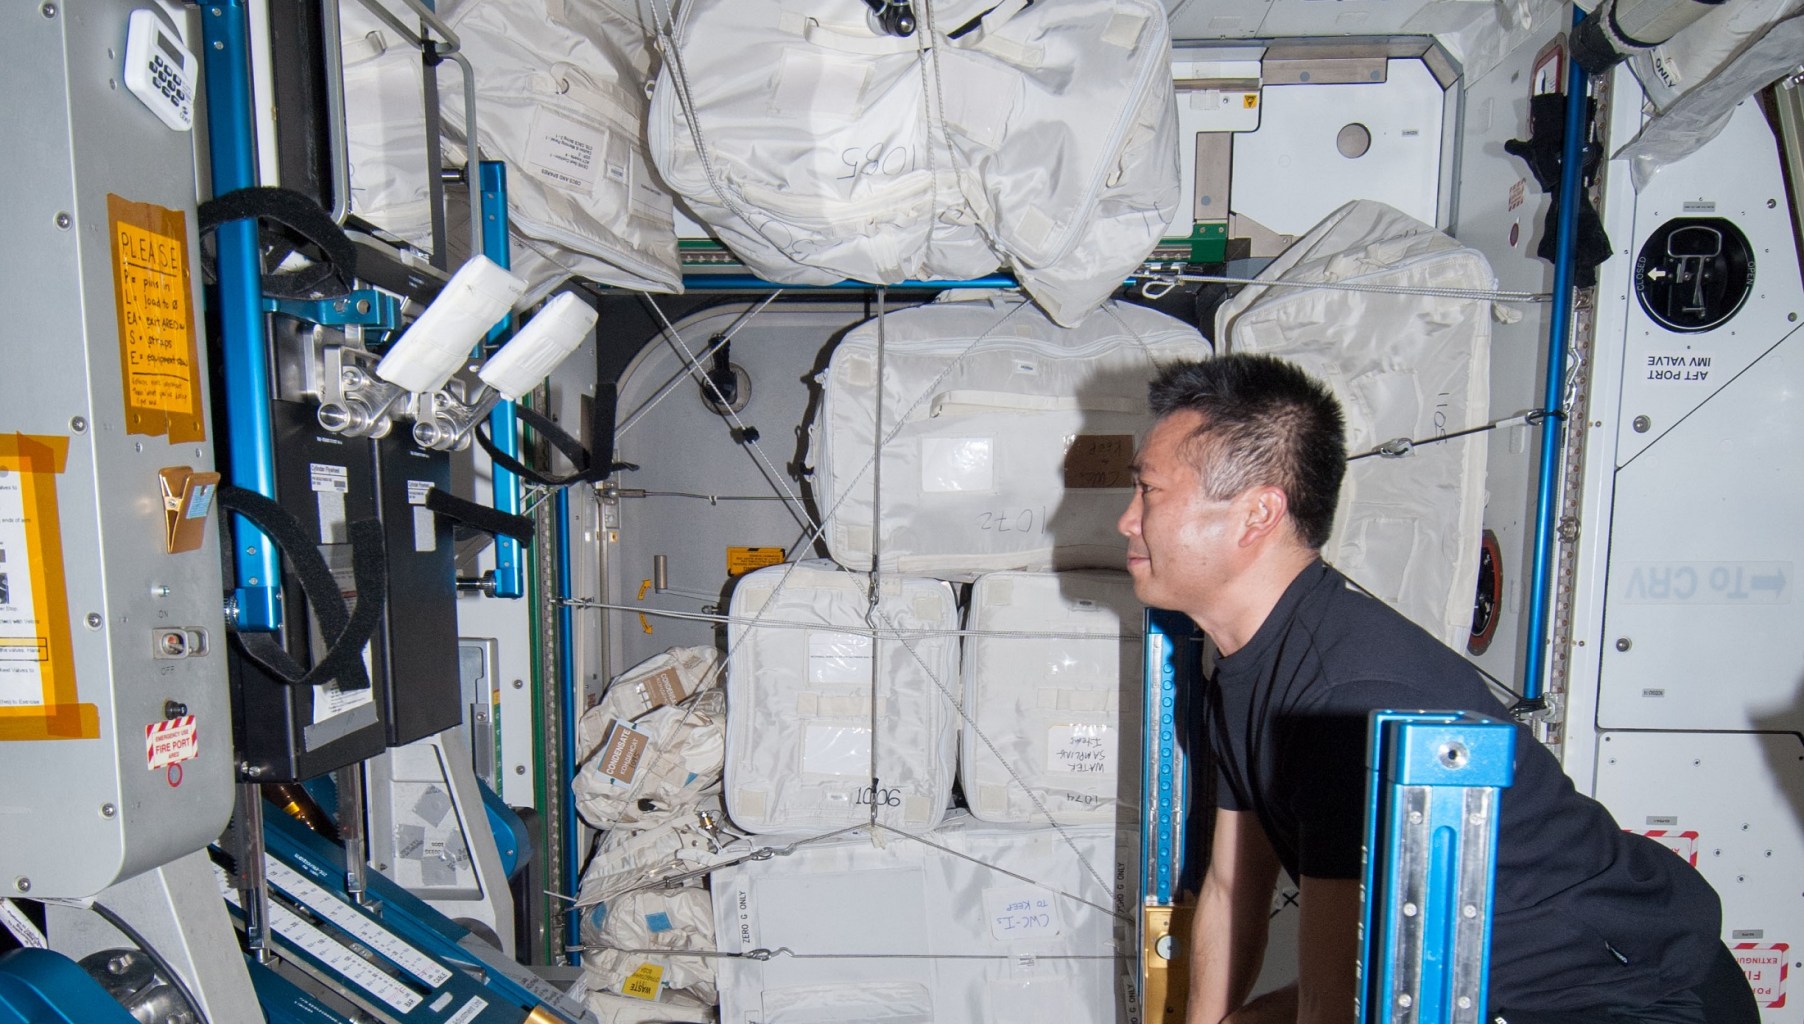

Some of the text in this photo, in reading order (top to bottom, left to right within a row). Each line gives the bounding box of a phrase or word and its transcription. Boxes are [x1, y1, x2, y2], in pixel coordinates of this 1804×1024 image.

[1656, 57, 1676, 89] ONLY
[1637, 256, 1648, 293] CLOSED
[1746, 260, 1757, 286] OPEN
[1648, 356, 1711, 367] IMV VALVE
[1647, 370, 1709, 381] AFT PORT
[1624, 566, 1749, 600] To CRV
[158, 610, 169, 618] ON
[161, 665, 175, 676] OFF
[155, 732, 181, 743] EMERGENCY
[155, 737, 190, 755] FIRE PORT
[606, 728, 631, 776] CONDENSATE
[620, 737, 639, 776] КОНДЕНСАТ
[1068, 763, 1104, 773] WATER
[1117, 862, 1125, 879] ONLY
[739, 890, 747, 911] ONLY
[1005, 902, 1031, 911] KEEP
[741, 923, 750, 944] ZERO
[433, 972, 449, 984] CABLE
[630, 982, 651, 995] WASTE
[1127, 984, 1136, 1003] ONLY
